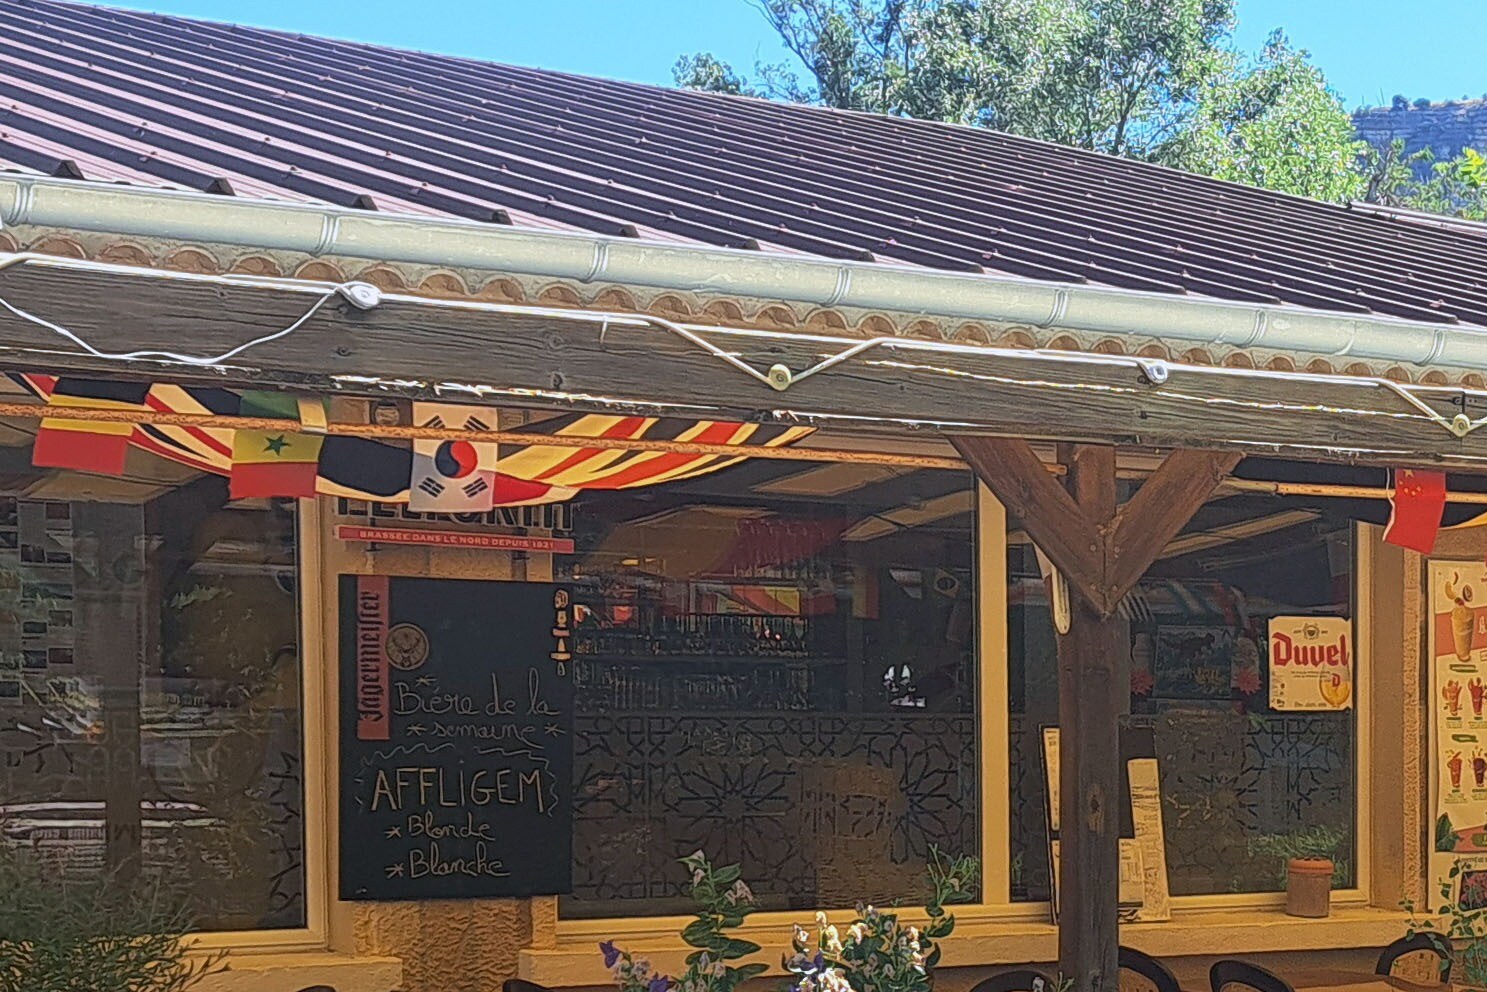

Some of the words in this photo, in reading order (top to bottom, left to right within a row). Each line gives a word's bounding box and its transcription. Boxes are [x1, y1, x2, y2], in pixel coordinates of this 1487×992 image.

[413, 533, 441, 543] DANS
[444, 535, 457, 544] LE
[460, 536, 489, 546] NORD
[492, 538, 529, 548] DEPUIS
[1272, 632, 1349, 668] Duvel
[486, 672, 517, 716] de
[527, 667, 561, 715] la
[431, 721, 545, 749] semaine
[370, 766, 544, 813] AFFLIGEM
[408, 809, 496, 841] Blonde
[409, 841, 511, 879] Blanche
